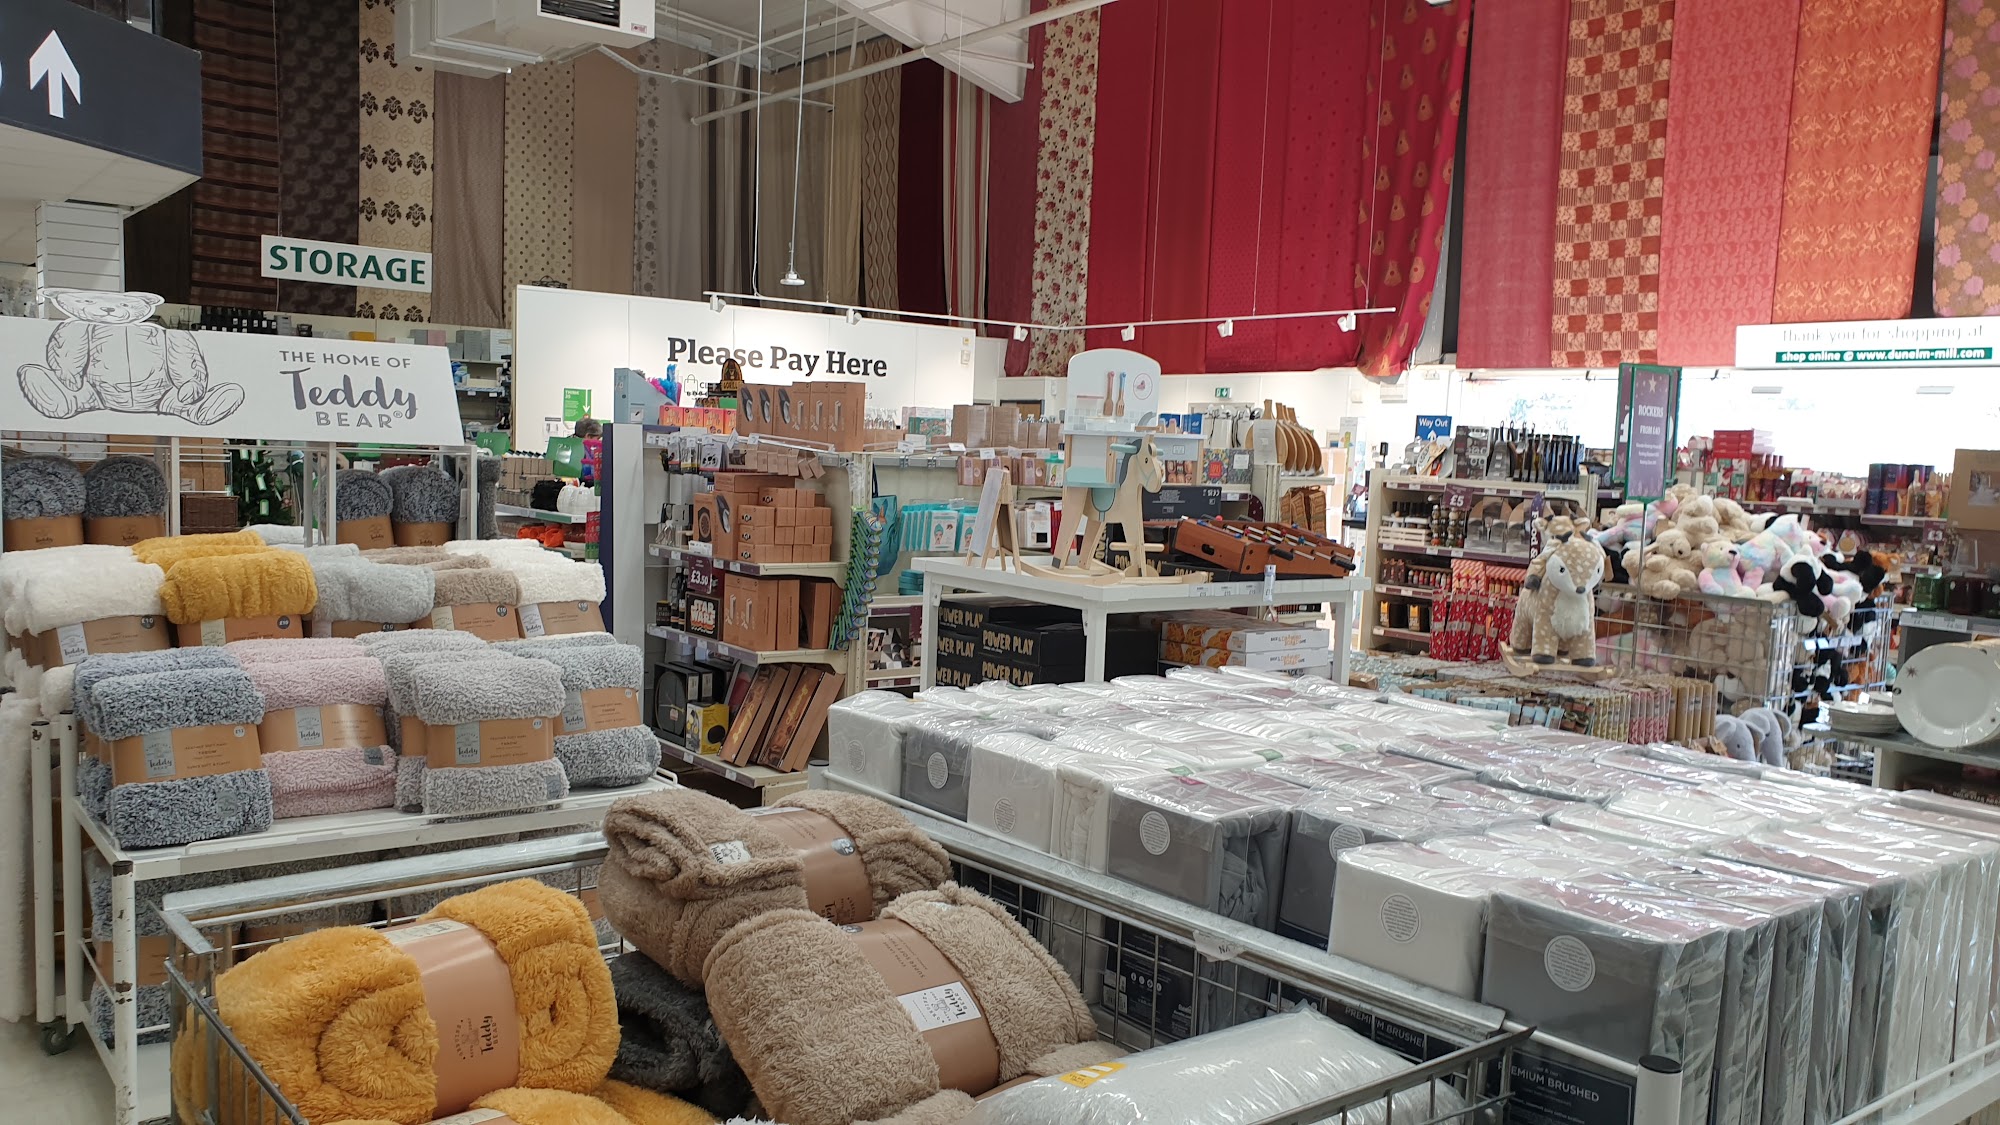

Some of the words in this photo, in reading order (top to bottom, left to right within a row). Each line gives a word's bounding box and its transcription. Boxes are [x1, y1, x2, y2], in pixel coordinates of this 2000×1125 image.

[269, 244, 426, 285] STORAGE
[1829, 331, 1856, 343] you
[1862, 327, 1881, 340] for
[1891, 325, 1961, 341] shopping
[1968, 325, 1983, 337] at
[279, 350, 316, 364] THE
[322, 353, 381, 367] HOME
[386, 357, 411, 369] OF
[667, 337, 763, 370] Please
[769, 345, 820, 377] Pay
[826, 350, 887, 377] Here
[1781, 351, 1806, 363] shop
[1808, 350, 1841, 362] online
[1856, 347, 1985, 361] www.dunelm-mill.com
[279, 367, 419, 420] Teddy
[1638, 404, 1664, 418] ROCKERS
[1418, 418, 1434, 429] Way
[1434, 418, 1449, 428] Out
[1640, 425, 1653, 435] FROM
[1449, 495, 1465, 507] £5
[1927, 529, 1943, 541] £3
[690, 569, 709, 586] £3.50
[691, 599, 715, 613] STAR
[691, 609, 716, 624] WARS
[938, 607, 964, 626] POWER
[965, 610, 984, 629] PLAY
[938, 637, 955, 654] WER
[956, 640, 975, 658] PLAY
[982, 629, 1011, 651] POWER
[1012, 635, 1034, 656] PLAY
[936, 667, 952, 684] WER
[953, 670, 972, 688] PLAY
[982, 661, 1011, 682] POWER
[1012, 667, 1034, 686] PLAY
[943, 988, 967, 1019] Teddy
[1344, 1006, 1385, 1031] PREMIM
[479, 1015, 494, 1055] Teddy
[1498, 1061, 1545, 1085] PEMIUM
[1547, 1078, 1600, 1103] BRUSHED
